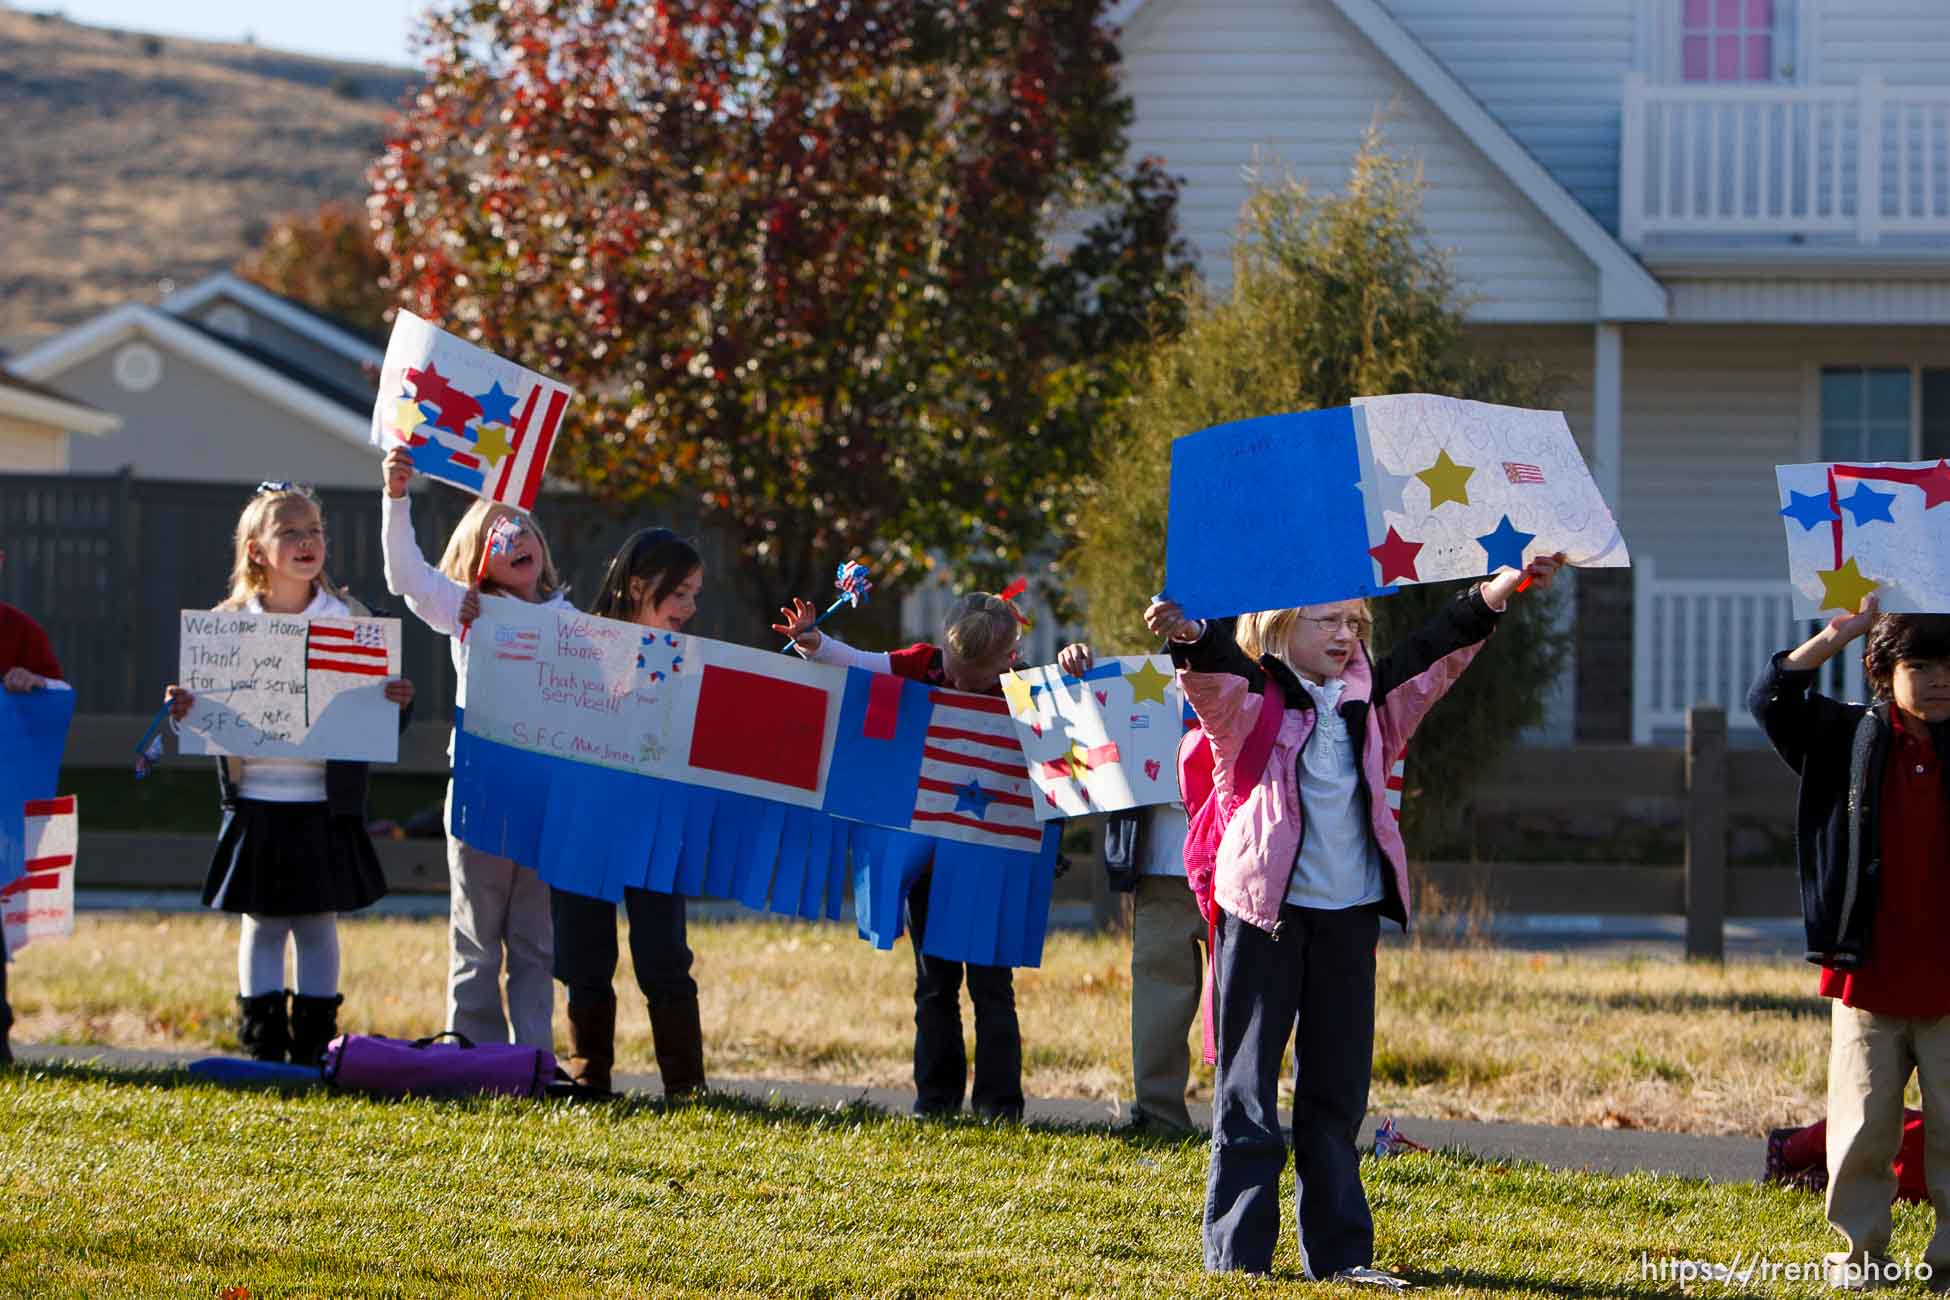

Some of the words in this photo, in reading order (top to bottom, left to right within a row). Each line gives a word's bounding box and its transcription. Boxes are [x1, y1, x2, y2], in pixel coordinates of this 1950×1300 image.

[184, 615, 257, 634] Welcome
[268, 619, 306, 636] Home
[188, 644, 241, 667] Thank
[252, 655, 282, 678] you
[556, 639, 604, 662] Home
[186, 670, 215, 690] for
[225, 677, 259, 704] your
[581, 679, 606, 698] you
